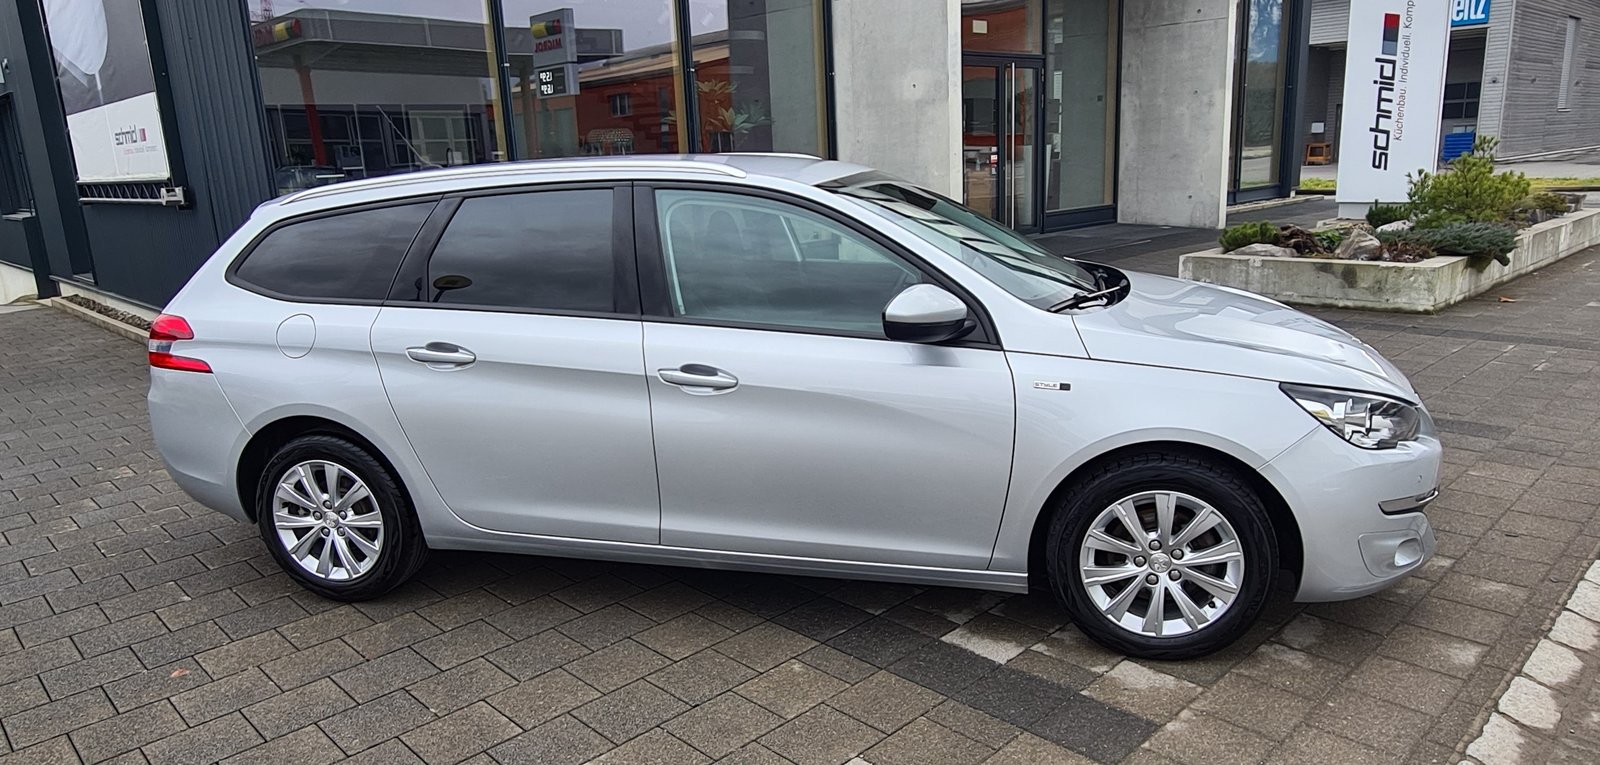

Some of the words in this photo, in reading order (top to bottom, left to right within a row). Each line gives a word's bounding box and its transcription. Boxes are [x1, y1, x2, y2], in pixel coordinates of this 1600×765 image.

[1403, 0, 1416, 29] Komp
[1399, 32, 1413, 83] Individuell.
[1369, 58, 1397, 171] schmid
[1393, 87, 1407, 141] Küchenbau.
